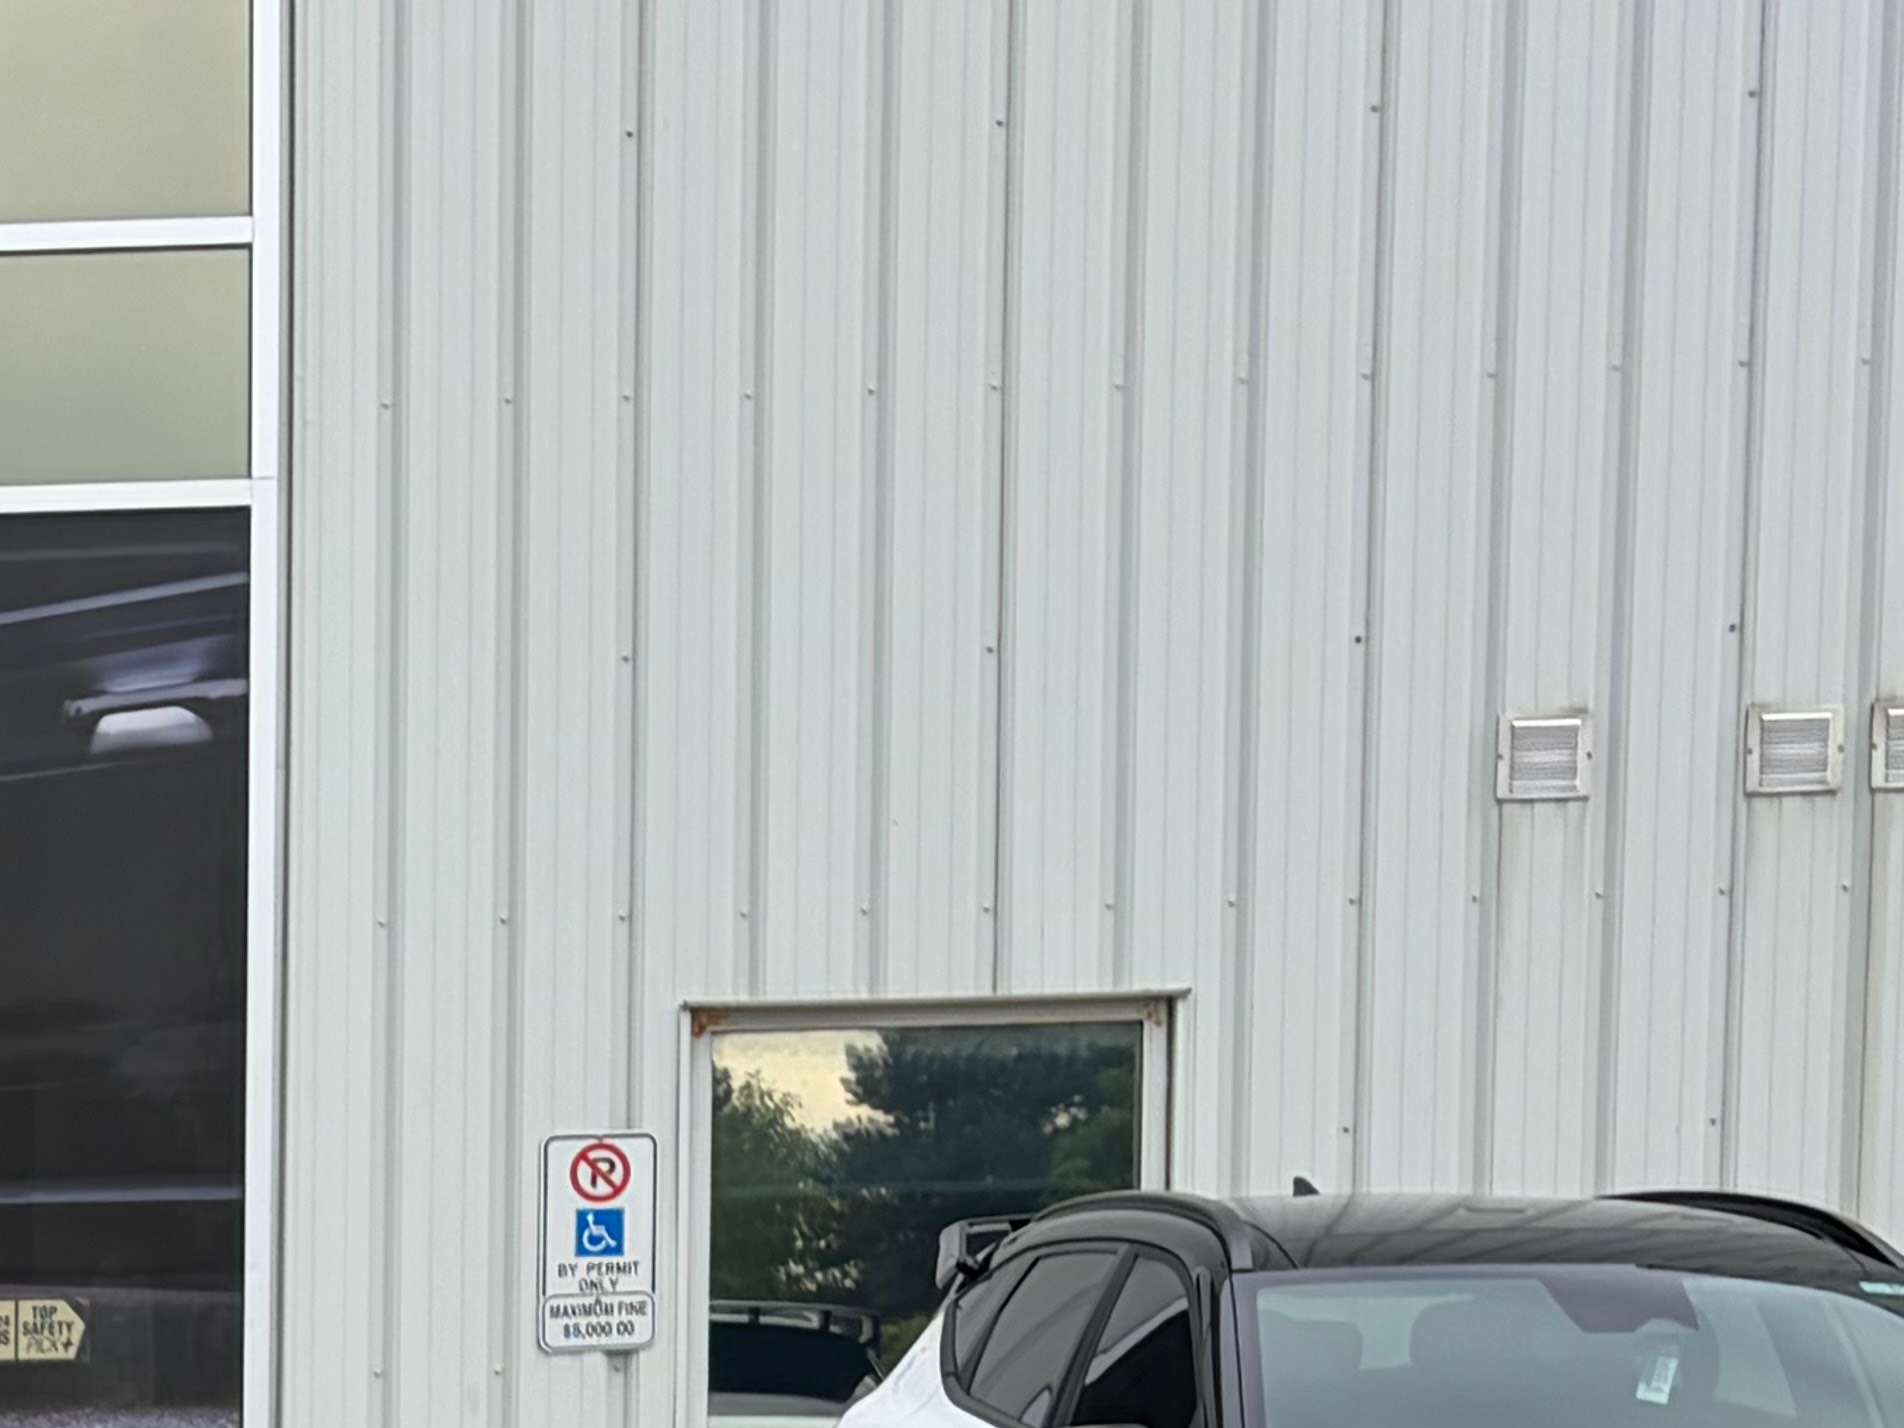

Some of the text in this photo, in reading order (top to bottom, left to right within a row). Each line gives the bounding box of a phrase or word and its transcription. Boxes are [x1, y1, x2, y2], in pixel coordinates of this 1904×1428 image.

[558, 1261, 639, 1278] BY PERMIT
[579, 1277, 619, 1293] ONLY
[32, 1305, 58, 1320] TOP
[549, 1300, 648, 1318] MAXIMUM FINE
[22, 1320, 74, 1337] SAFETY
